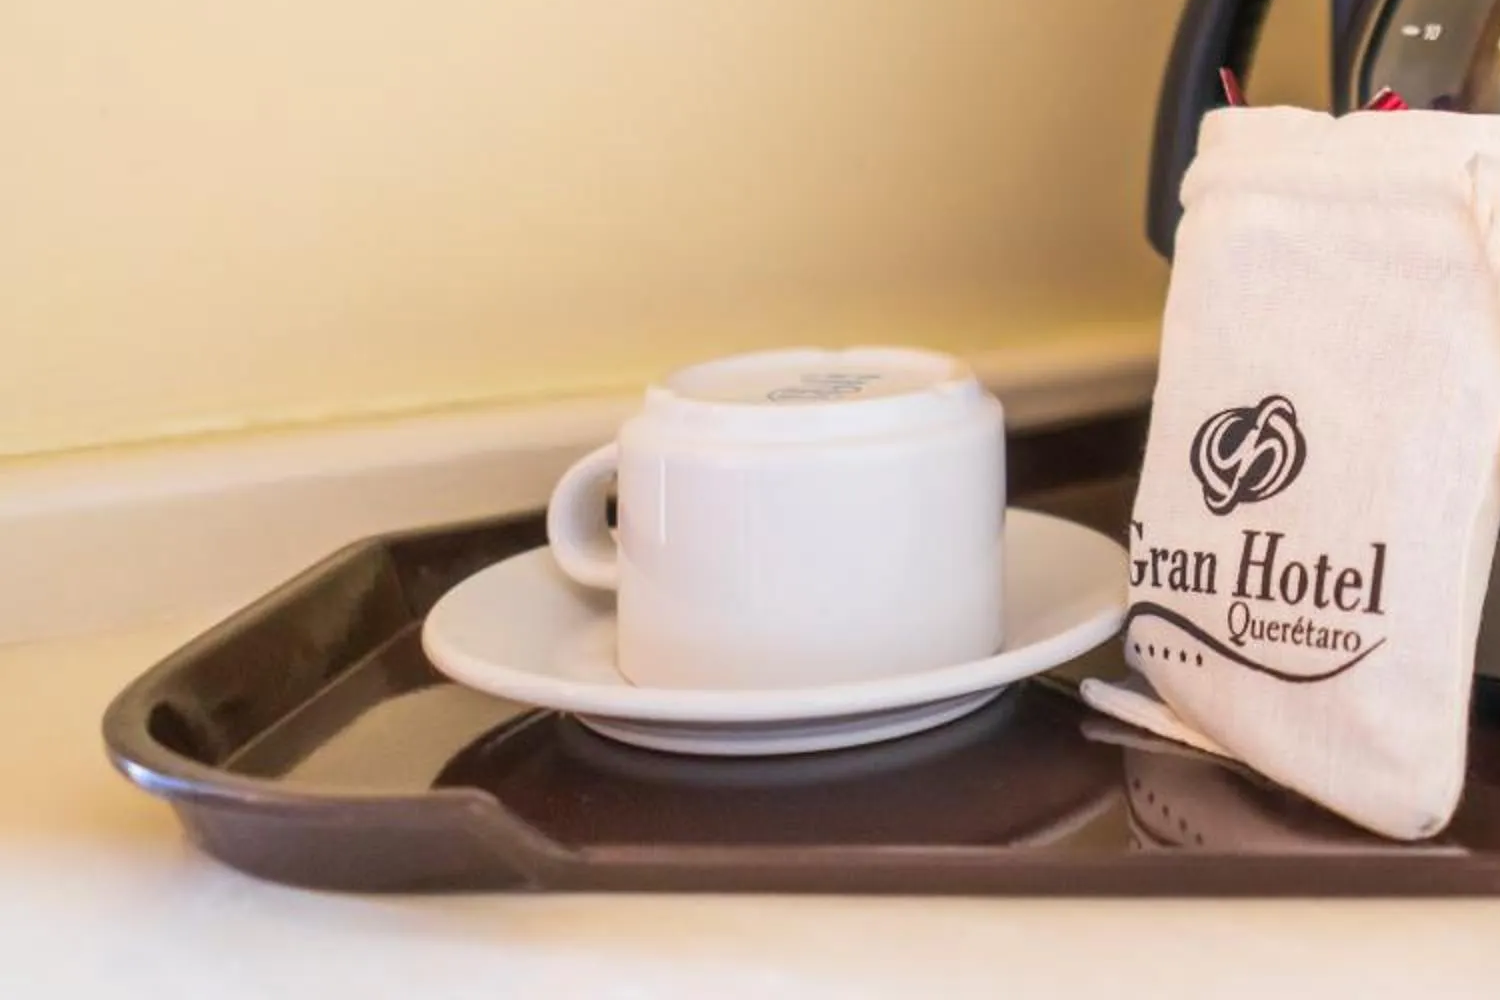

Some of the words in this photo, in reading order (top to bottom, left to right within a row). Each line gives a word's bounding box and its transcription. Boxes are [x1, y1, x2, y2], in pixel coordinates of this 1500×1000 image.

[1129, 519, 1217, 594] Gran
[1231, 529, 1387, 615] Hotel
[1226, 601, 1362, 652] Querétaro
